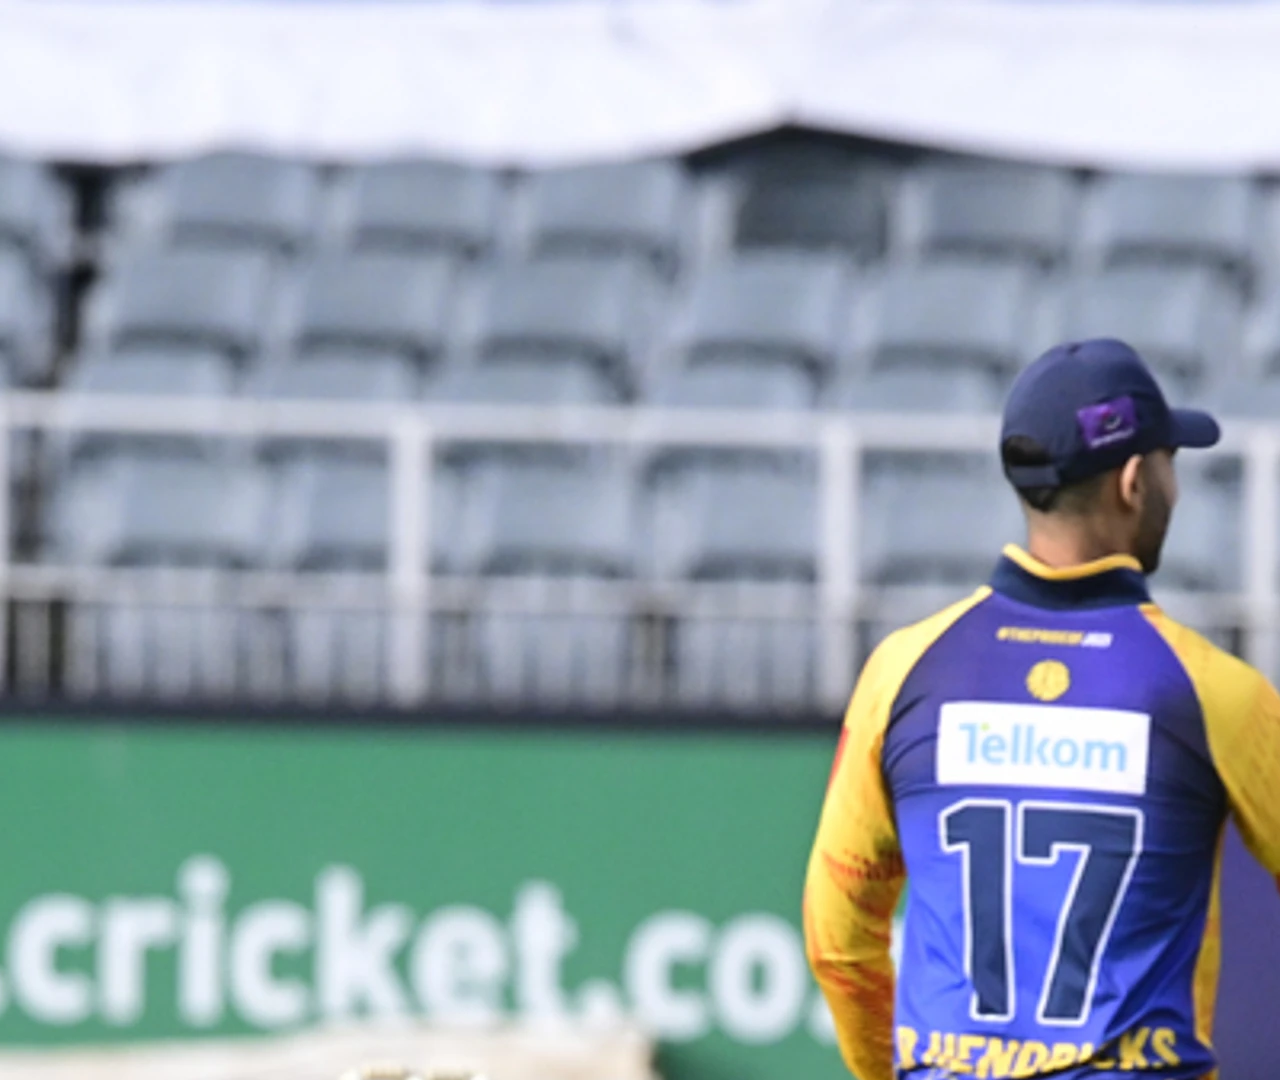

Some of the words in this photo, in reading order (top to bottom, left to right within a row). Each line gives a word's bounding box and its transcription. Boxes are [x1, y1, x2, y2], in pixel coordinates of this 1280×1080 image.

[958, 721, 1128, 772] Telkom
[937, 797, 1144, 1027] 17
[921, 1026, 1181, 1080] HENDRIKS
